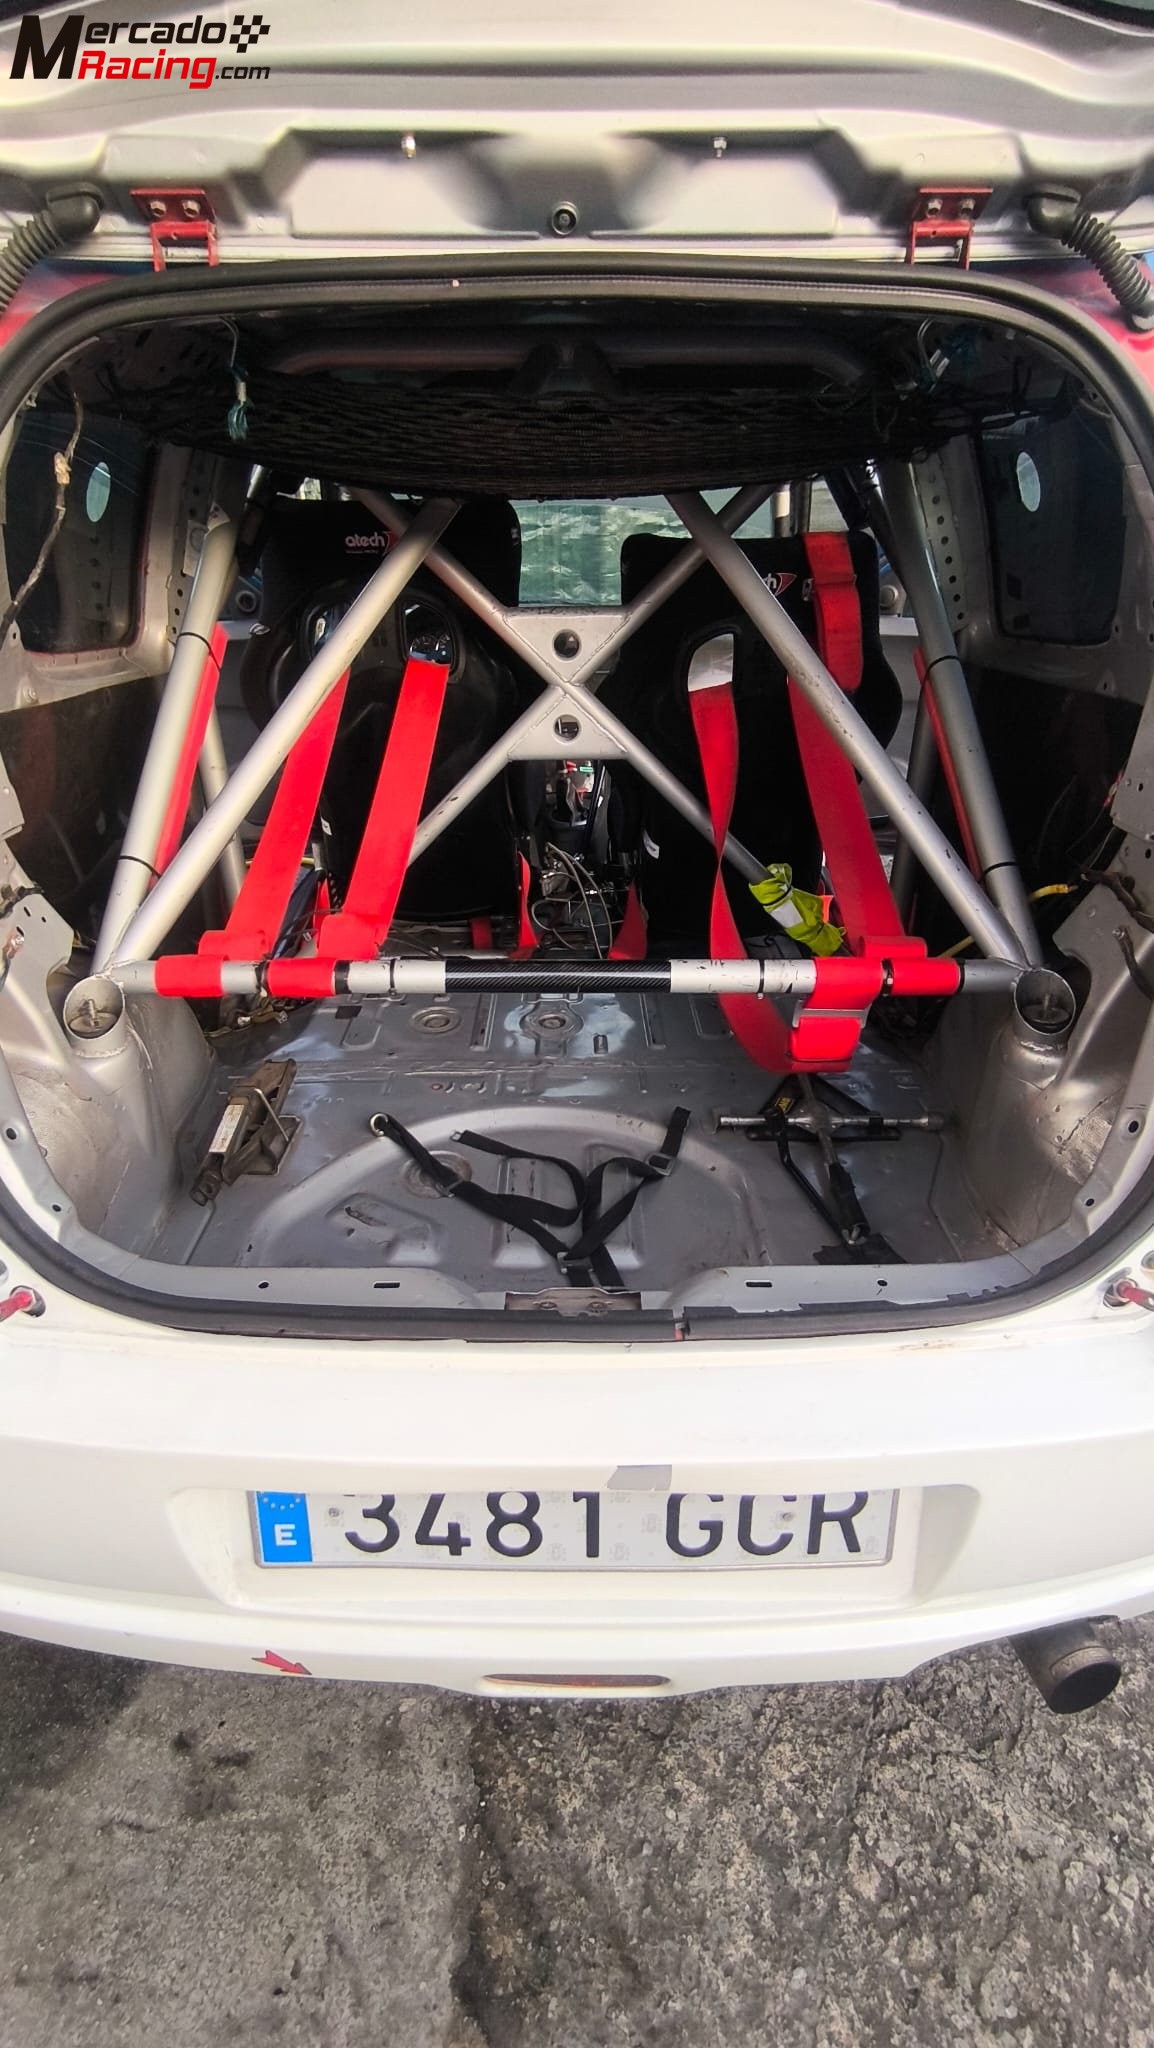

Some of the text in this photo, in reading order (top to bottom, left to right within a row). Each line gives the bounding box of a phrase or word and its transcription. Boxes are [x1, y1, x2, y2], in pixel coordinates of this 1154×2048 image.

[274, 1523, 297, 1546] E
[344, 1490, 869, 1558] 3481 GCR
